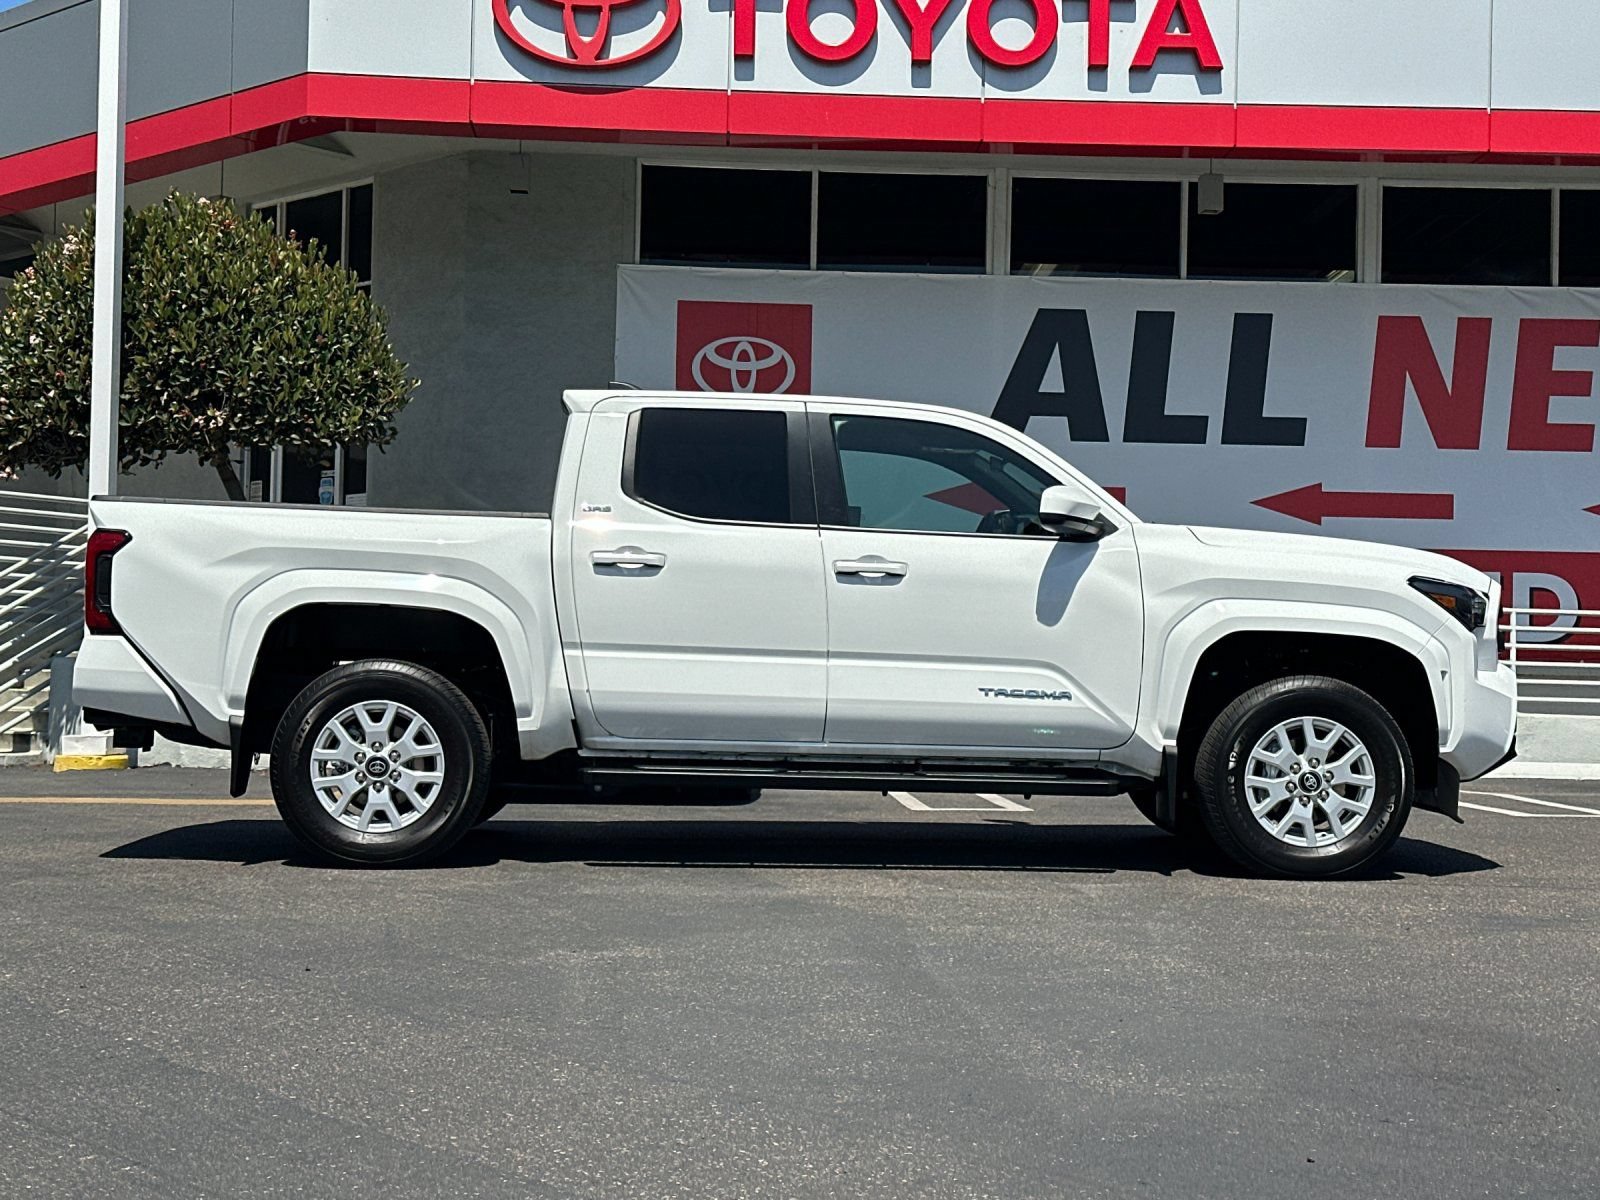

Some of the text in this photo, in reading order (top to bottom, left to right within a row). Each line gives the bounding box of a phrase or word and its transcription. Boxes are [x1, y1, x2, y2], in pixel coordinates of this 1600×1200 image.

[734, 0, 1223, 71] TOYOTA
[990, 307, 1600, 453] ALL NE
[978, 687, 1073, 701] TACOMA
